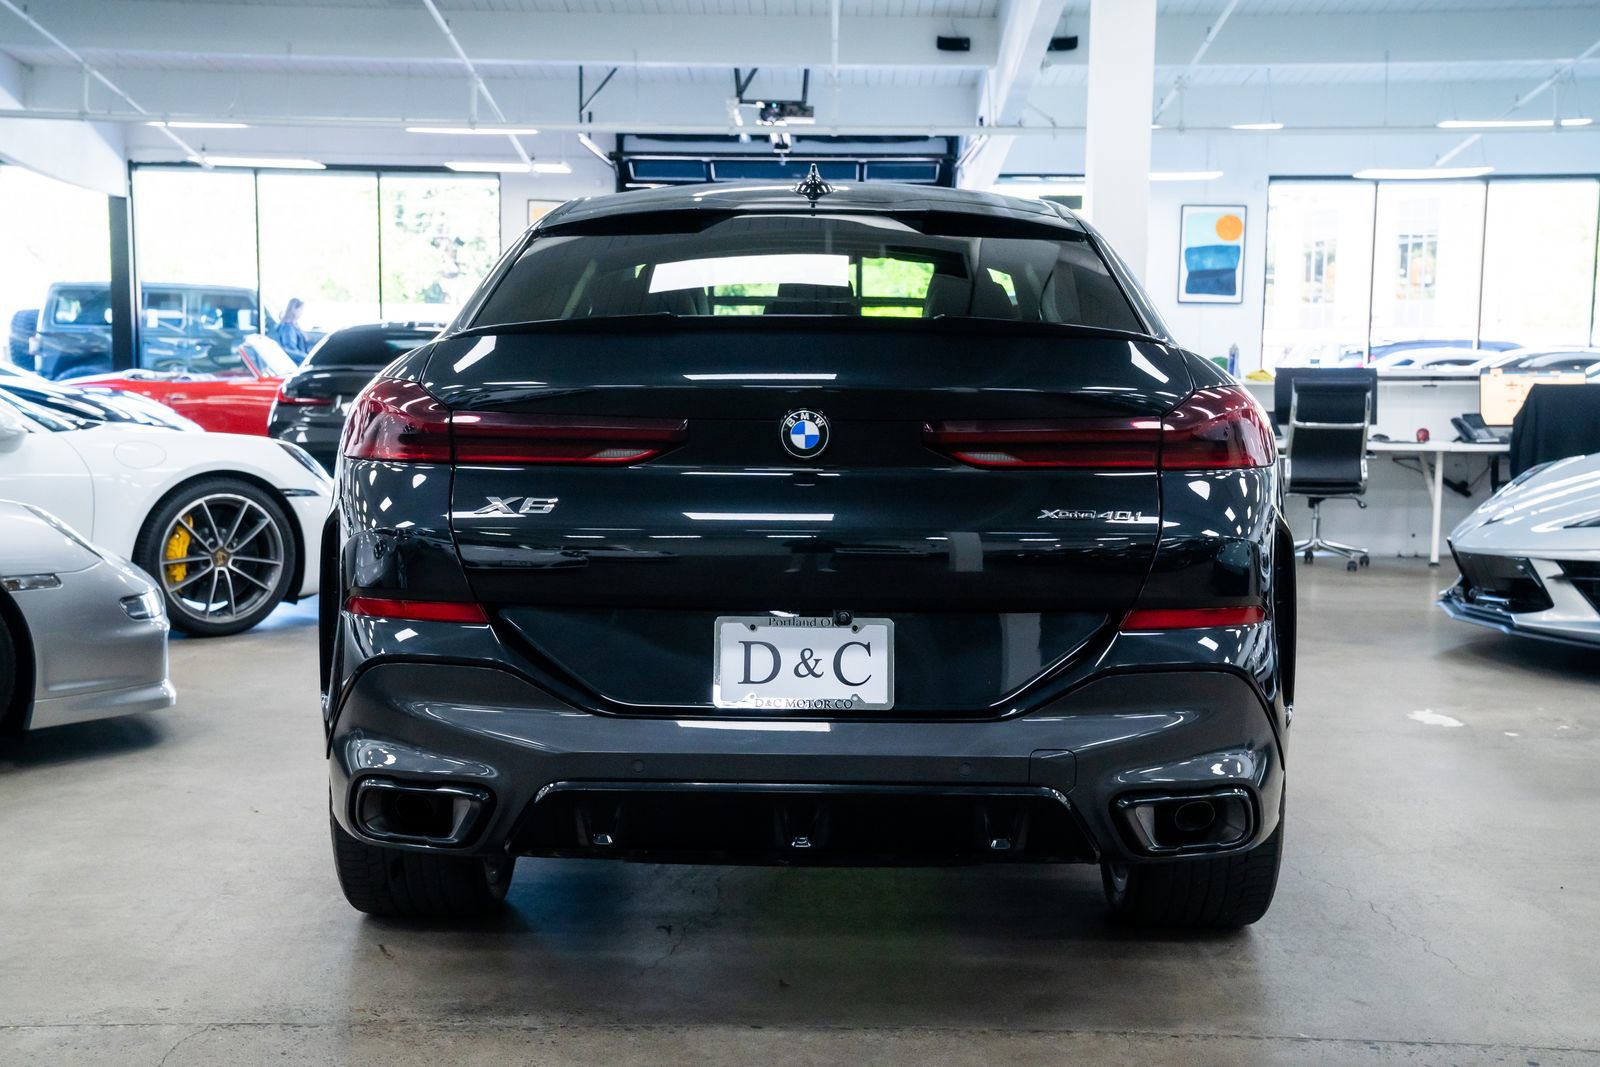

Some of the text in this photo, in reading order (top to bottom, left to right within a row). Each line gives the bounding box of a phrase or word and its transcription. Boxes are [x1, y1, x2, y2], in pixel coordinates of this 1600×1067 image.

[786, 412, 825, 428] BMW
[473, 496, 559, 514] X6
[768, 617, 817, 627] Portland
[737, 640, 872, 686] D & C
[755, 699, 853, 709] D&C MOTOR CO
